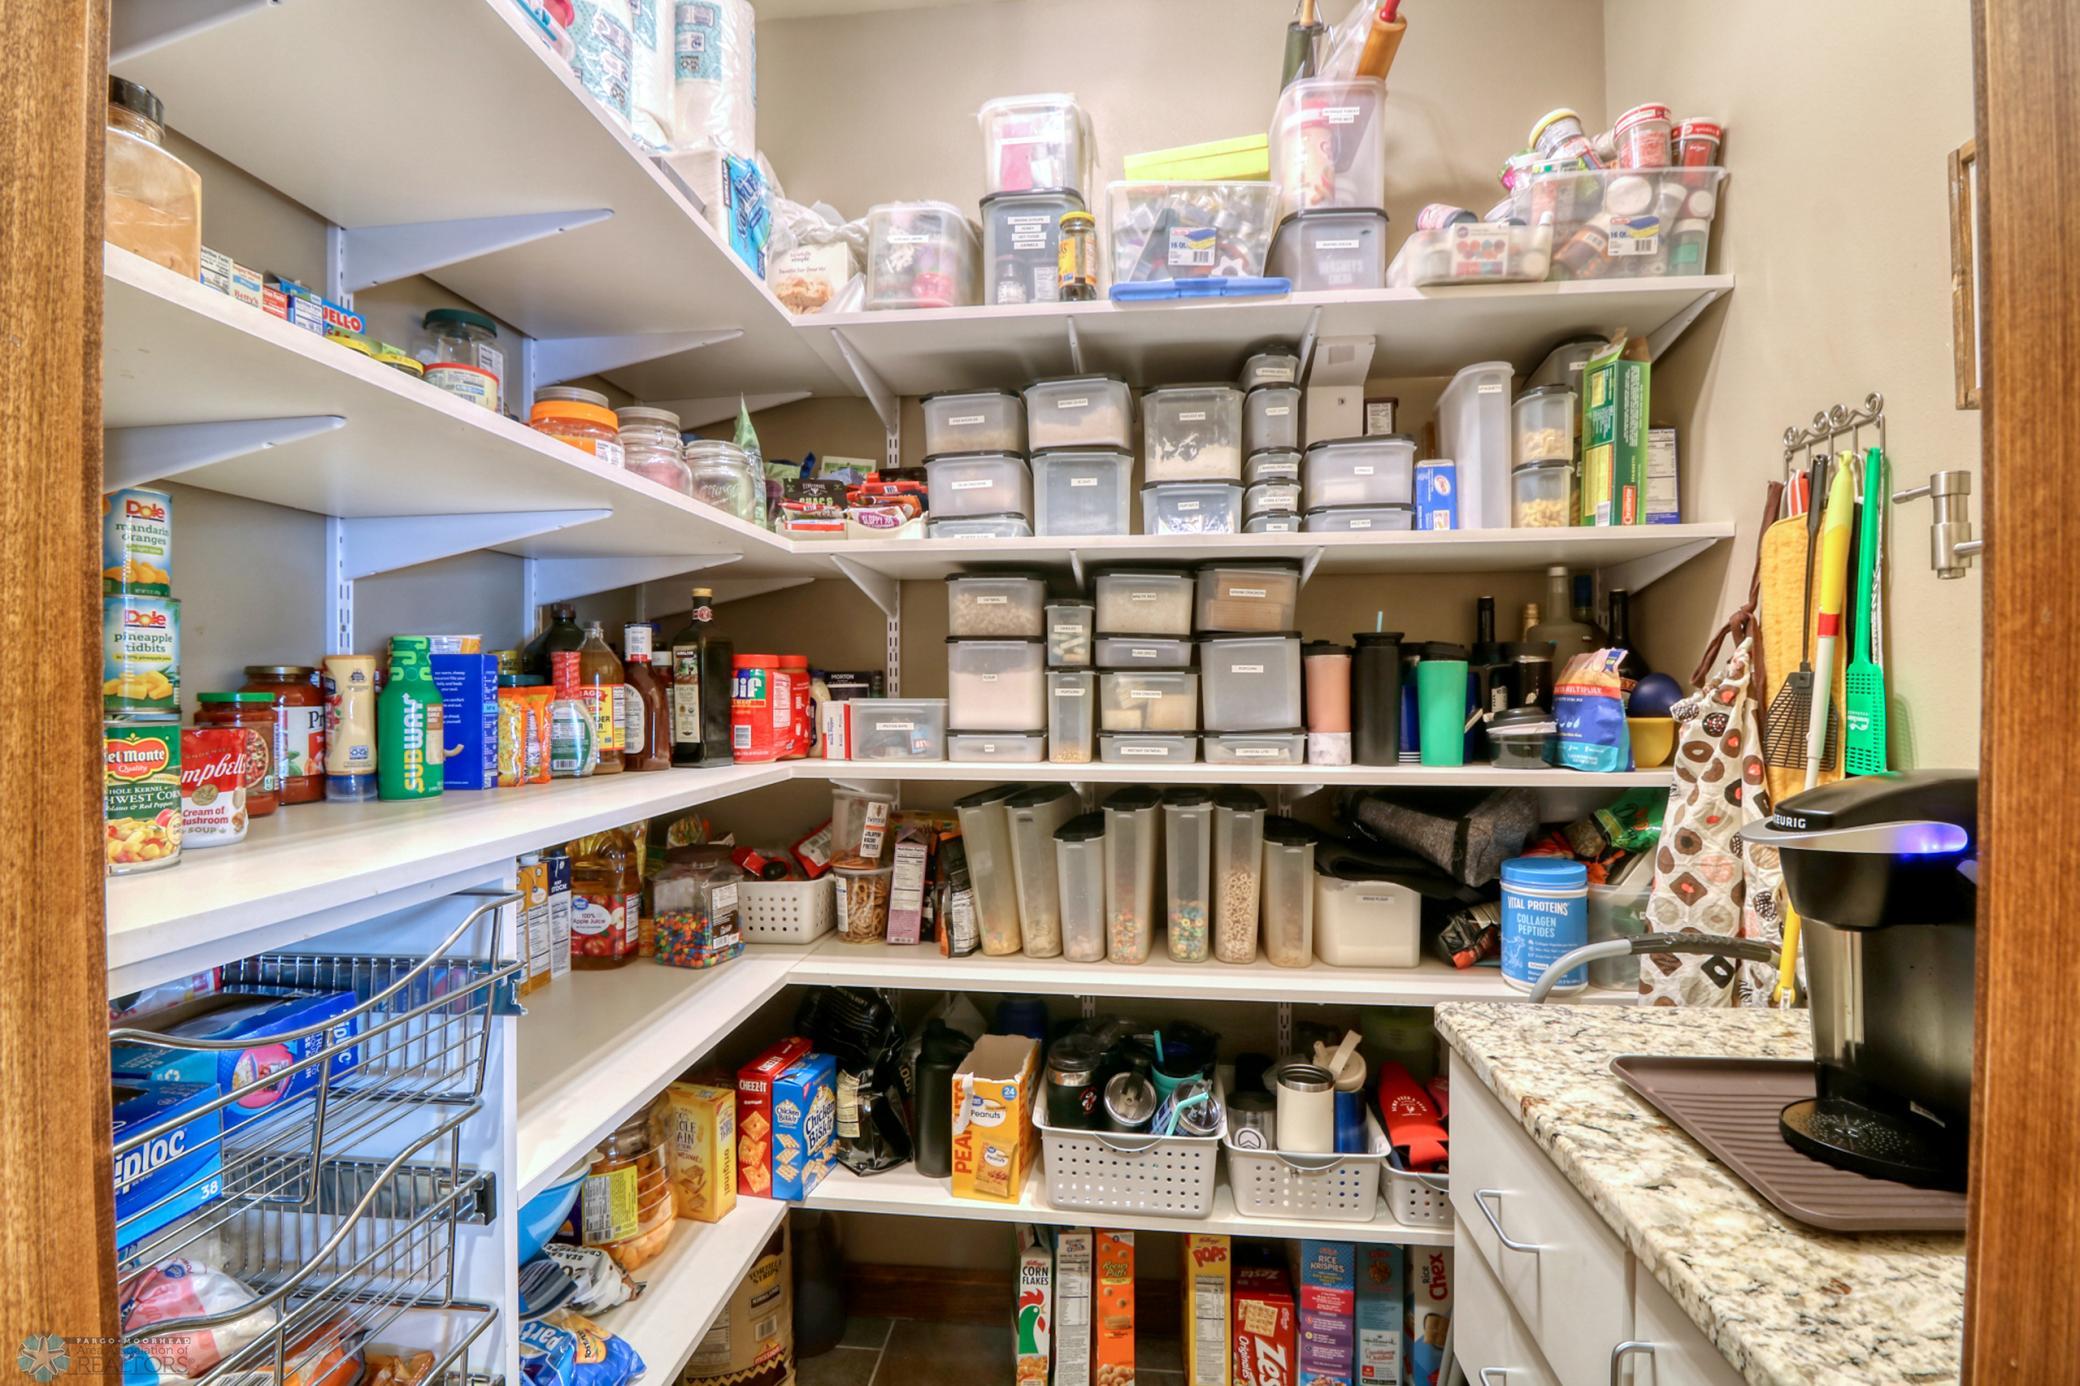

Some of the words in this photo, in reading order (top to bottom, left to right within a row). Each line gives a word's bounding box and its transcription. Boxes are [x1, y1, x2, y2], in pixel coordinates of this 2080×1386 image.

[126, 499, 165, 518] Dole
[115, 523, 170, 537] mandarin
[122, 534, 166, 546] oranges
[125, 609, 166, 627] Dole
[114, 631, 173, 644] pineapple
[126, 642, 167, 653] tidbits
[404, 693, 424, 793] SUBWAY
[123, 749, 166, 764] Monte
[118, 763, 149, 776] Quality
[134, 786, 162, 797] KERNEL
[138, 802, 155, 810] Red
[182, 809, 213, 821] Cream
[214, 805, 226, 819] of
[188, 826, 218, 834] SOUP
[1507, 896, 1526, 910] VITAL
[1527, 900, 1569, 917] PROTEINS
[1516, 912, 1557, 928] COLLAGEN
[1518, 923, 1556, 938] PEPTIDES
[330, 1009, 352, 1064] iplc
[738, 1079, 768, 1093] CHEEZ-IT
[1003, 1087, 1016, 1097] 24
[806, 1101, 836, 1135] Chicken
[970, 1109, 1001, 1119] Peanuts
[113, 1130, 187, 1196] iploc
[722, 1148, 731, 1195] original
[201, 1180, 219, 1200] 38
[1192, 1246, 1227, 1268] POPS
[1318, 1255, 1338, 1265] RICE
[1022, 1265, 1050, 1278] CORN
[1310, 1261, 1345, 1273] KRISPIES
[1022, 1276, 1050, 1286] FLAKES
[1420, 1265, 1430, 1285] Rice
[1427, 1252, 1449, 1301] Chex
